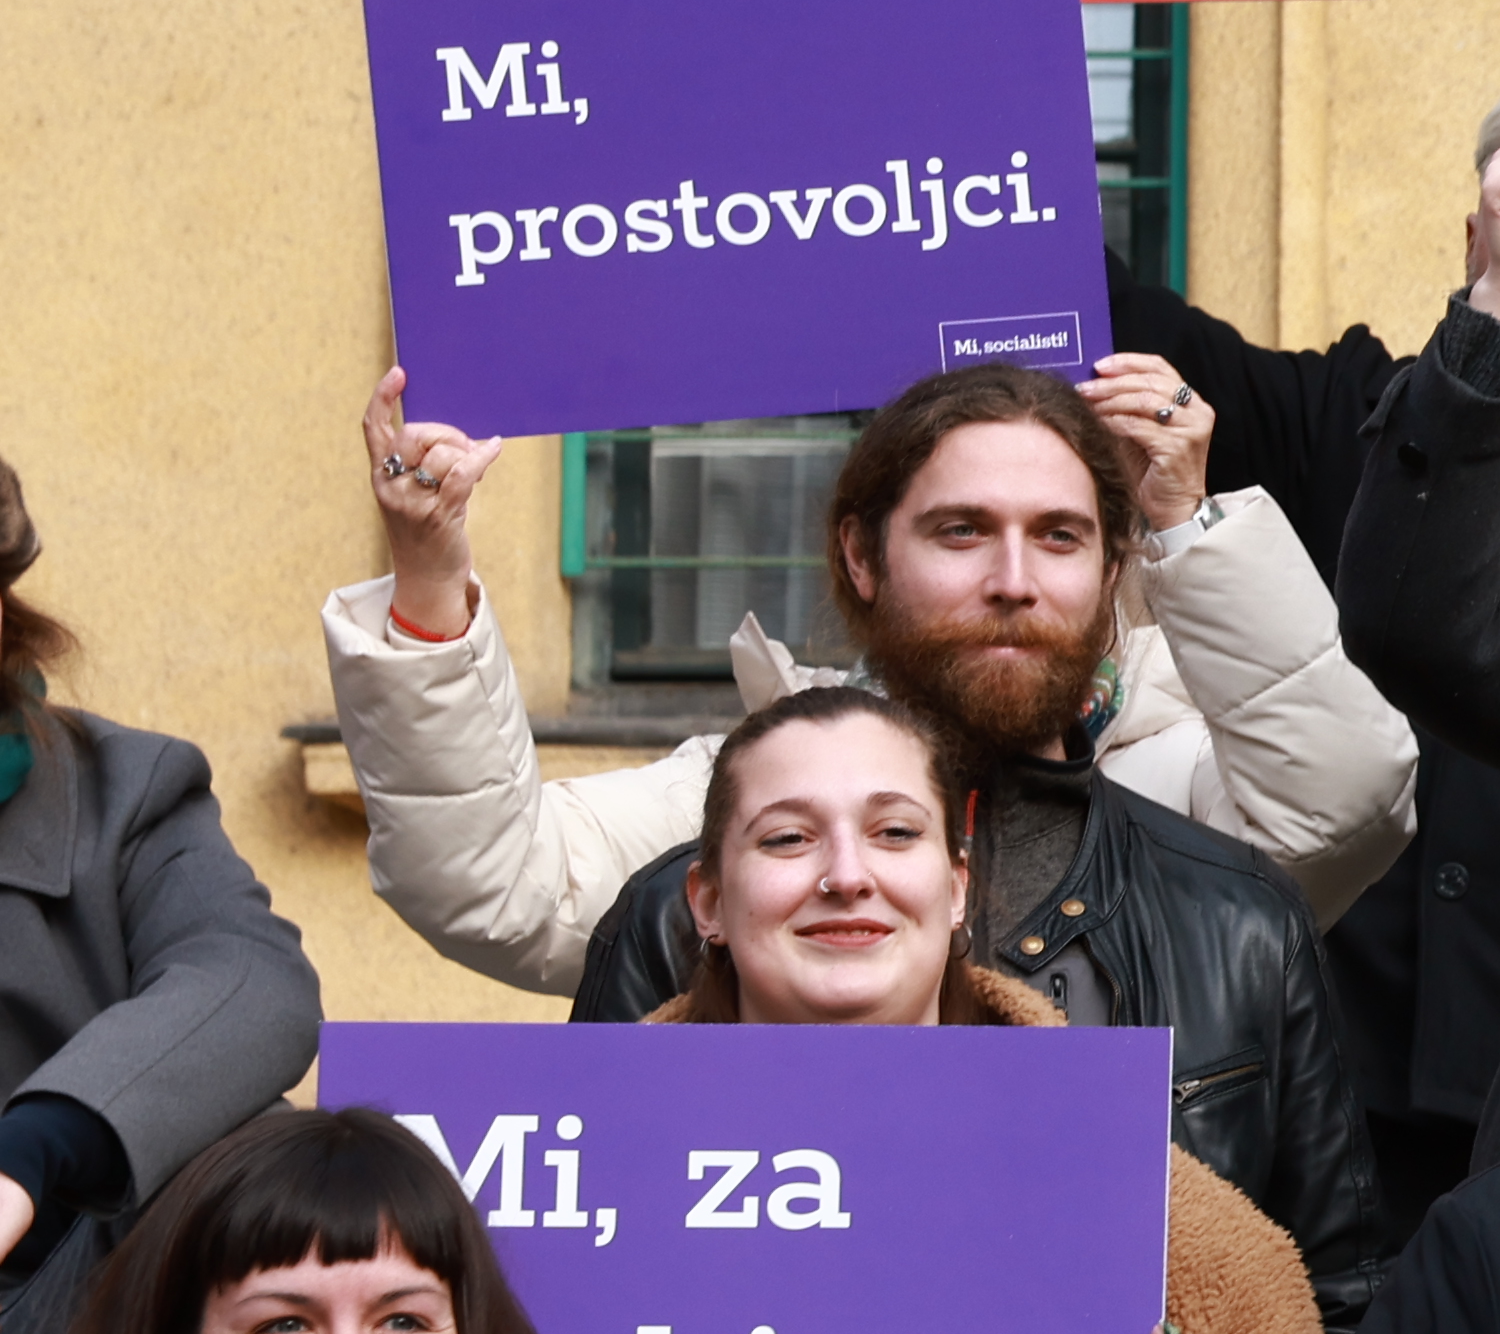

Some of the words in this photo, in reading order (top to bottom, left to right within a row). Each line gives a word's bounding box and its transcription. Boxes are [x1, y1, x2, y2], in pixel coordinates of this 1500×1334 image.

[436, 41, 588, 124] Mi,
[449, 151, 1055, 286] prostovoljci.
[954, 339, 982, 355] Mi,
[984, 332, 1067, 353] socialisti!
[686, 1150, 850, 1229] za
